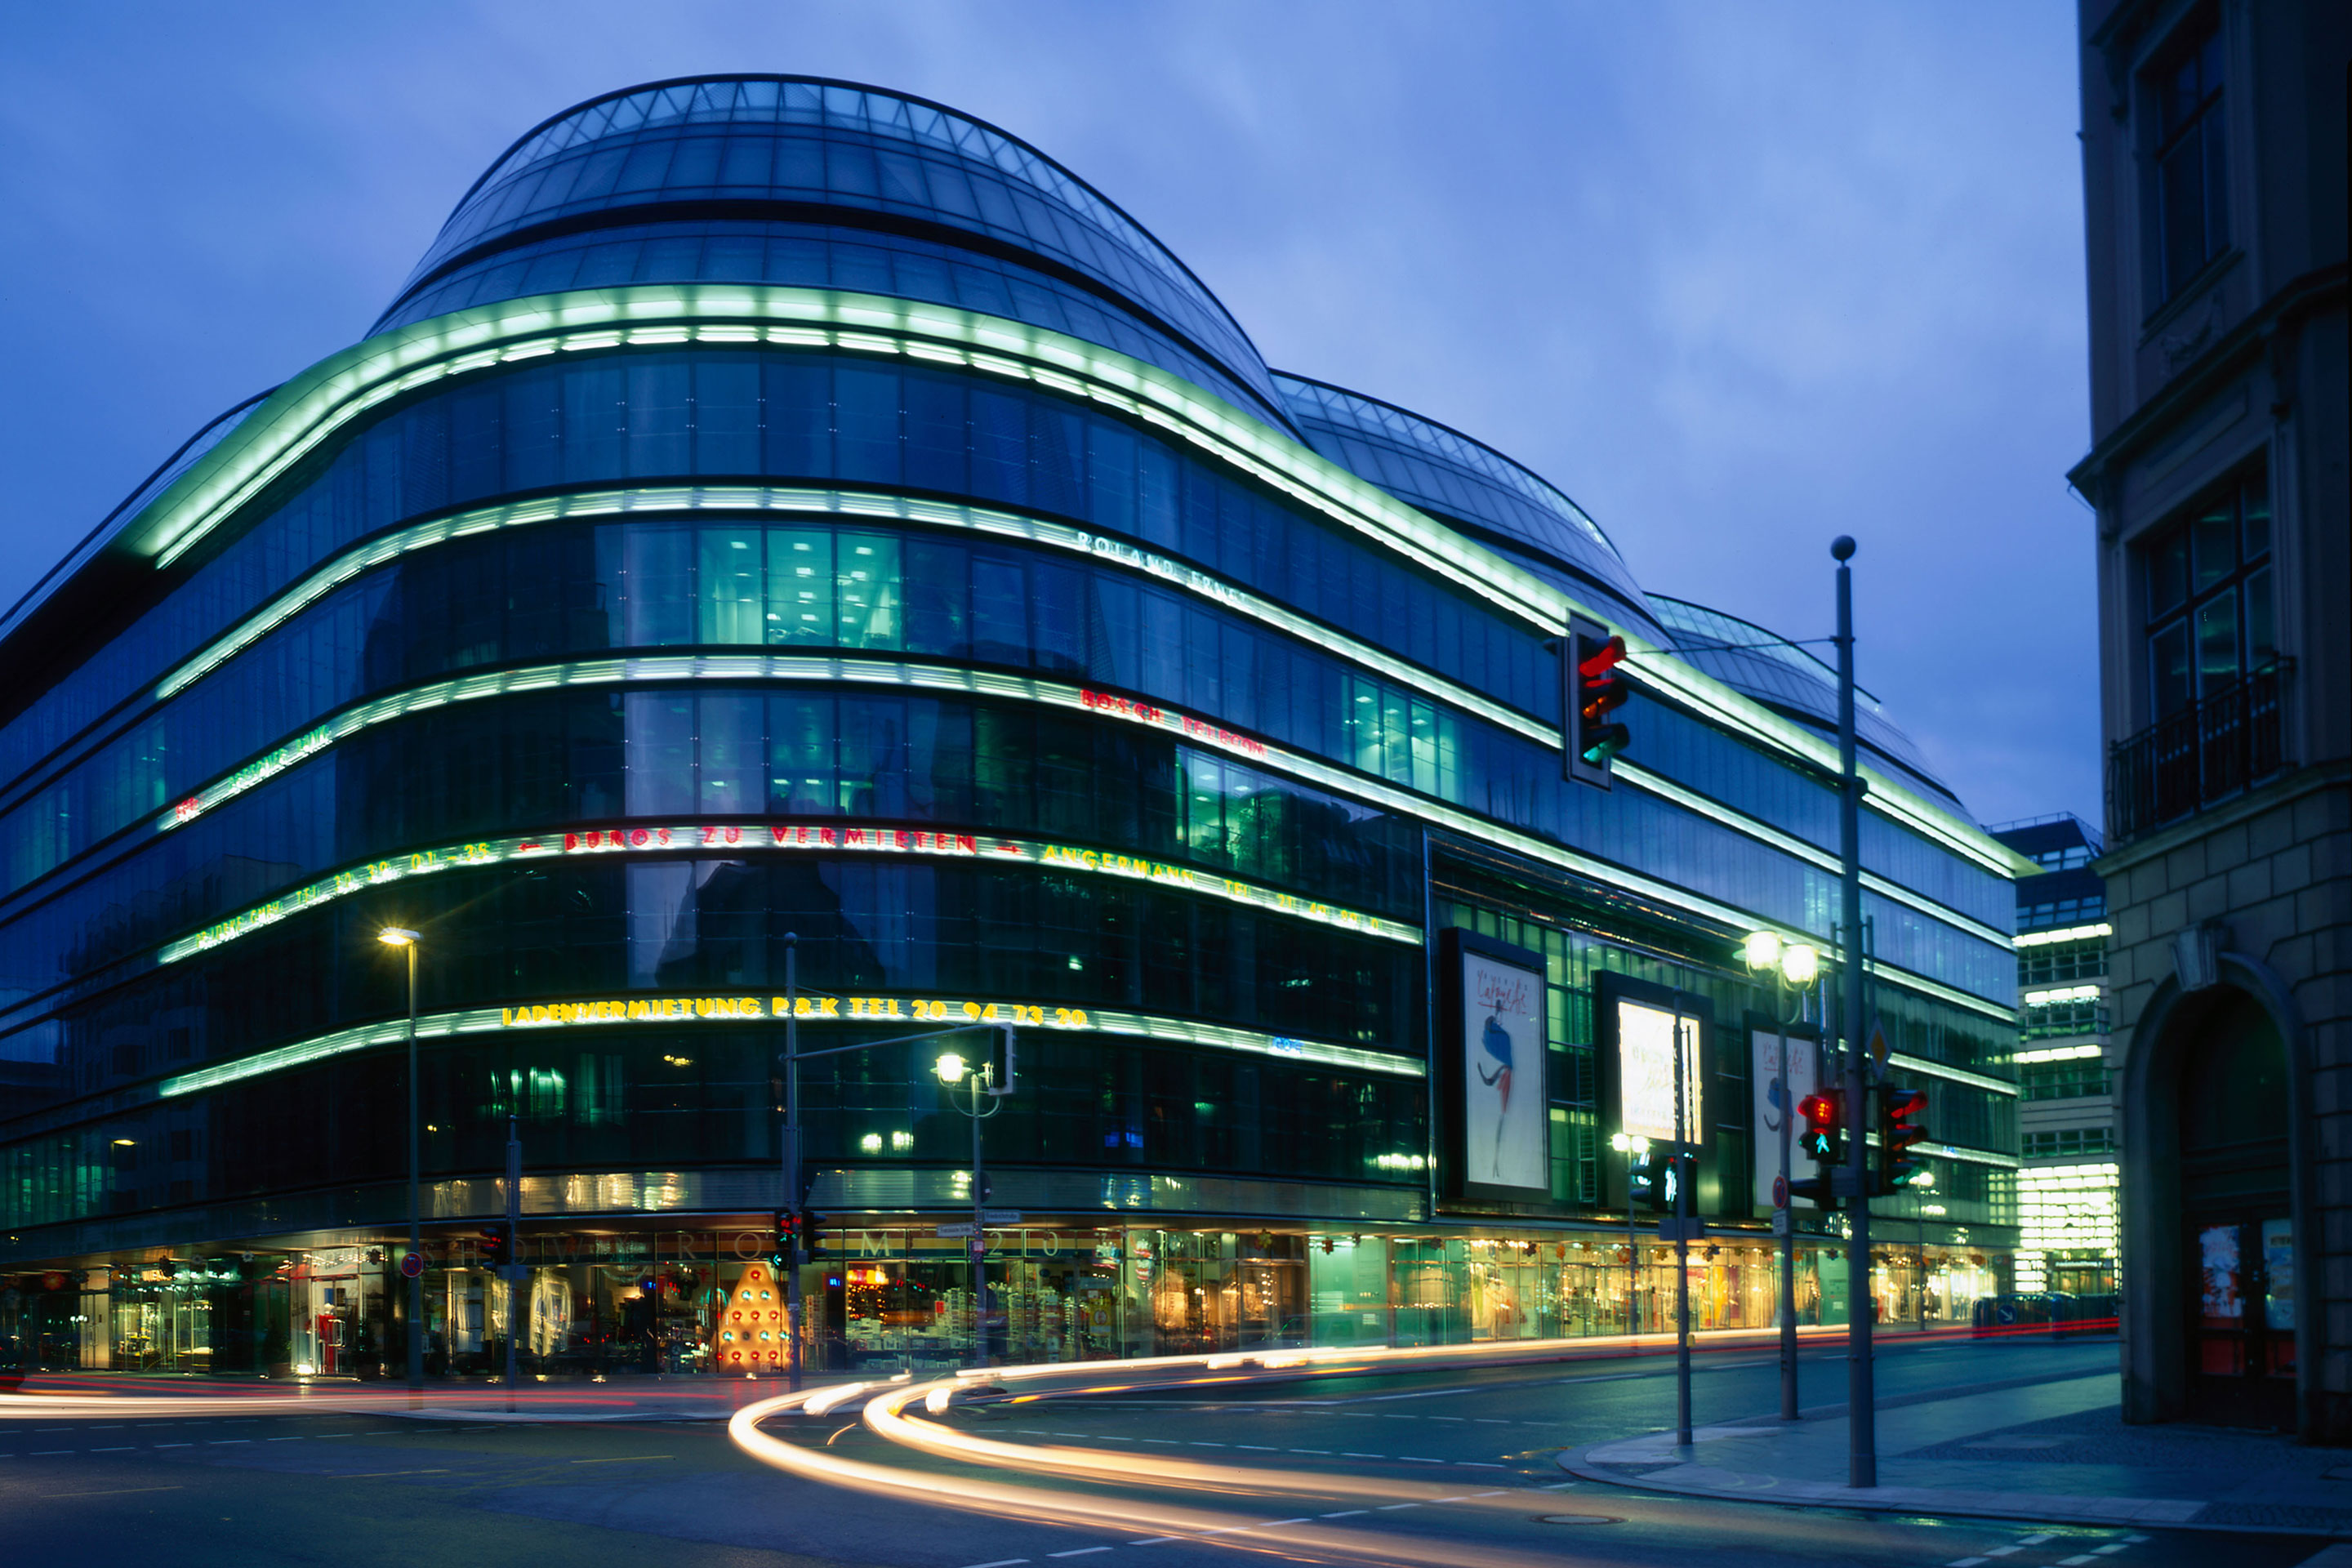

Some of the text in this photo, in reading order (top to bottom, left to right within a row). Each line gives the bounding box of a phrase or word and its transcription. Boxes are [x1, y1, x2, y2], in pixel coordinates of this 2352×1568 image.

[1080, 688, 1268, 756] BOSCH TELECOM
[701, 826, 743, 844] ZU
[770, 826, 977, 855] VERMIETEN
[295, 884, 318, 905] TEL
[411, 851, 434, 871] 01
[463, 842, 490, 862] 35
[1043, 844, 1196, 884] ANGERMANN
[1223, 879, 1250, 898] TEL
[1276, 893, 1295, 910] 21
[501, 997, 761, 1026] LADENVERMIETUNG
[849, 997, 898, 1016] TEL
[911, 999, 947, 1018] 20
[962, 1001, 999, 1022] 94
[1013, 1004, 1044, 1025] 73
[1054, 1007, 1088, 1026] 20
